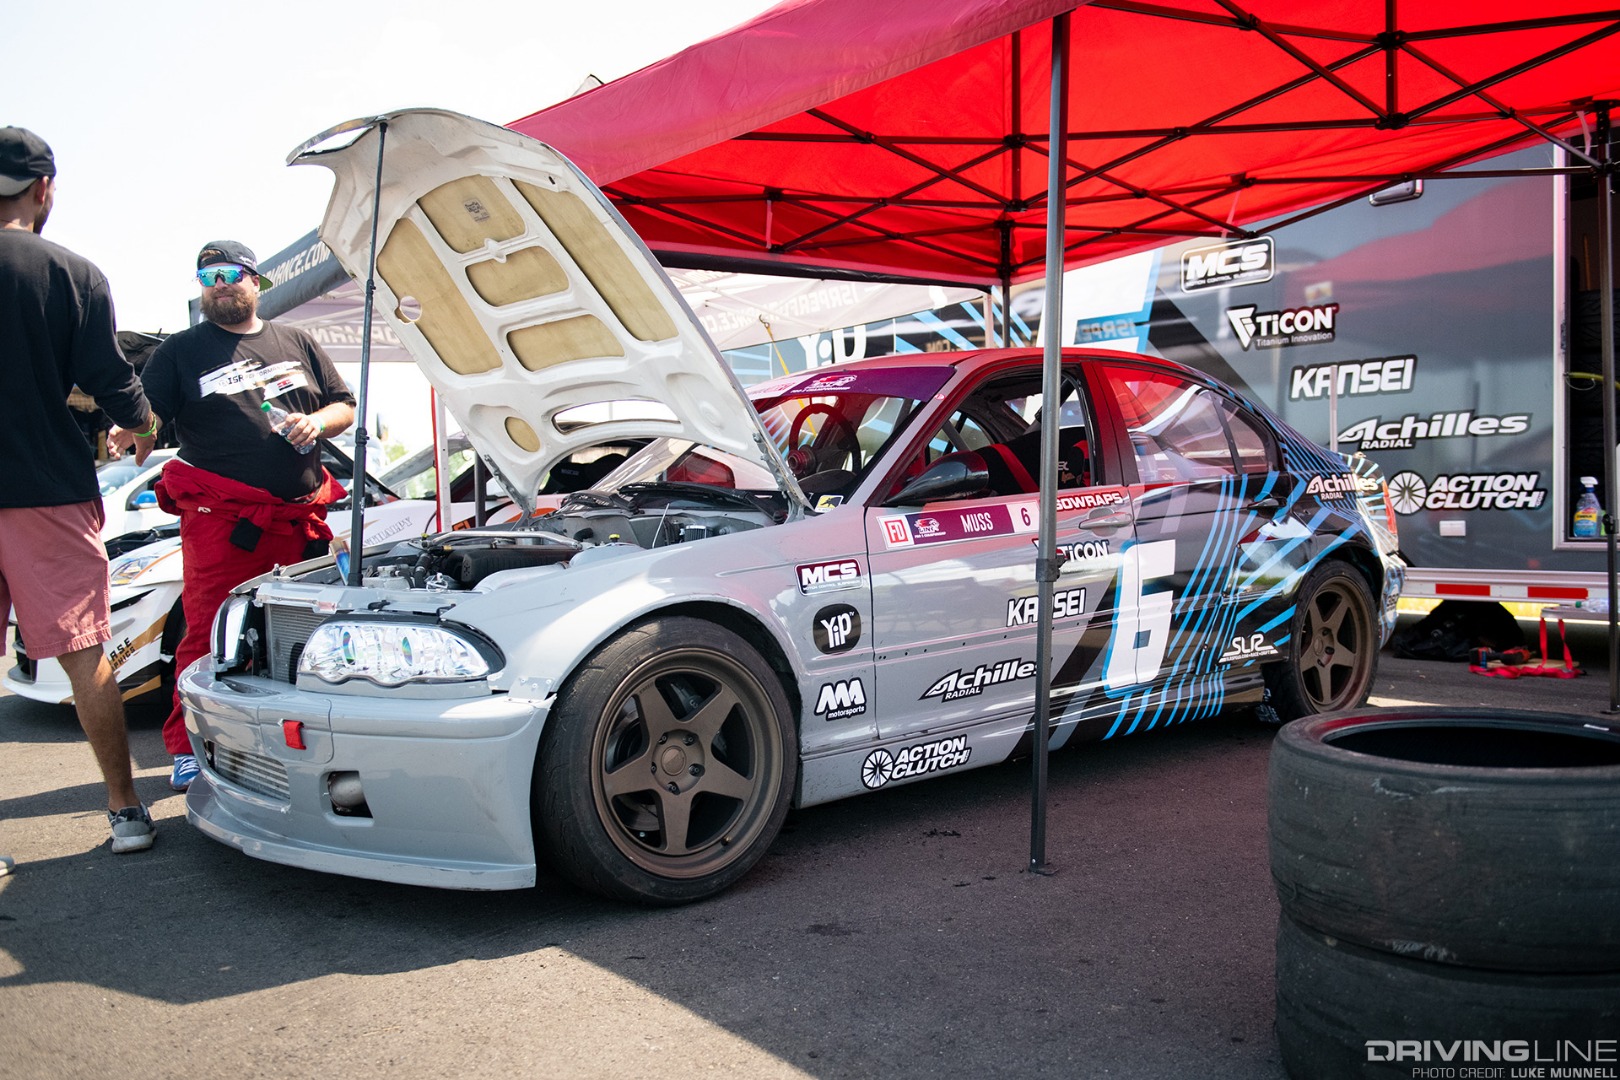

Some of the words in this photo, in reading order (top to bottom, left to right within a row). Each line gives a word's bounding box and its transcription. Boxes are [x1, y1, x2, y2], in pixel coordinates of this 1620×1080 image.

[1187, 244, 1269, 281] MCS
[1257, 338, 1290, 347] Titanium
[1291, 332, 1333, 344] Innovation
[1291, 359, 1415, 399] KANSEI
[1337, 412, 1528, 442] Achilles
[1361, 439, 1412, 450] RADIAL
[1306, 473, 1379, 494] Achilles
[1428, 474, 1538, 493] ACTION
[1321, 492, 1344, 500] RADIAL
[1425, 491, 1540, 509] CLUTCH
[889, 520, 907, 542] FD
[959, 511, 994, 533] MUSS
[1020, 507, 1031, 527] 6
[801, 562, 857, 586] MCS
[1007, 588, 1086, 627] KASEI
[1107, 539, 1176, 689] 6
[1223, 633, 1274, 658] SLR
[945, 686, 981, 700] RADIAL
[828, 706, 865, 719] motorsports
[894, 736, 966, 765] ACTION
[892, 751, 967, 780] CLUTCH
